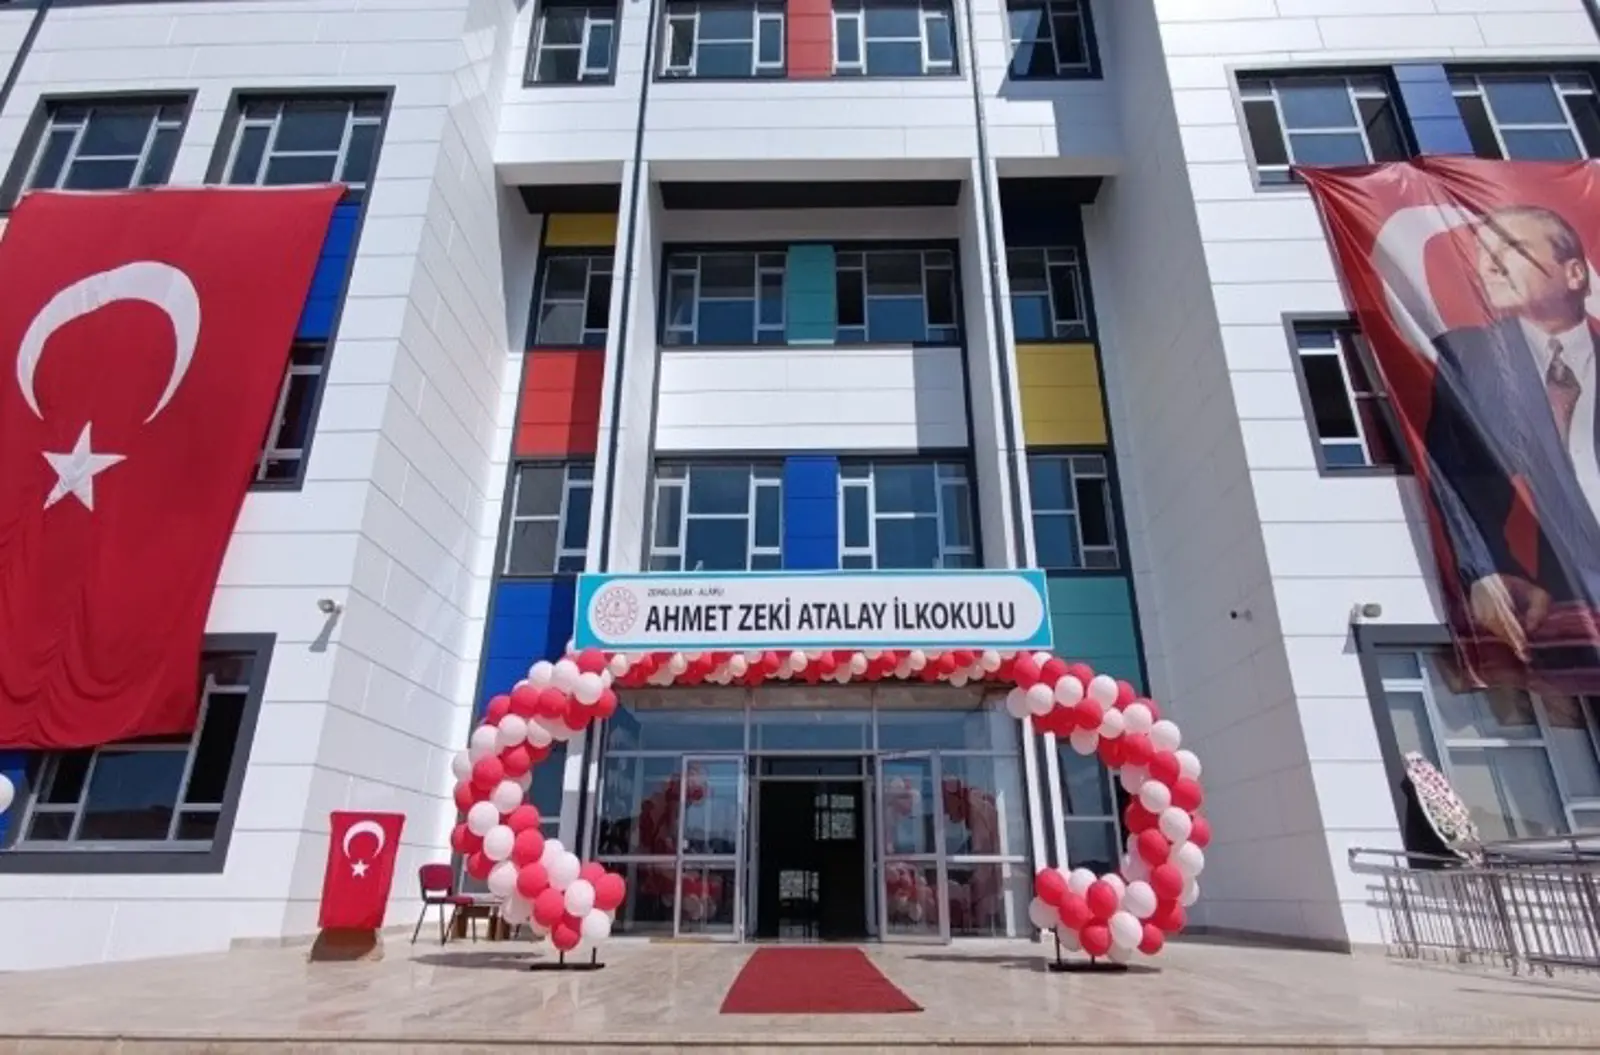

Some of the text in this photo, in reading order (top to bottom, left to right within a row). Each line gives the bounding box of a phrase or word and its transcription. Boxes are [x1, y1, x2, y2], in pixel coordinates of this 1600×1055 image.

[645, 596, 1015, 632] AHMET ZEKİ ATALAY İLKOKULU
